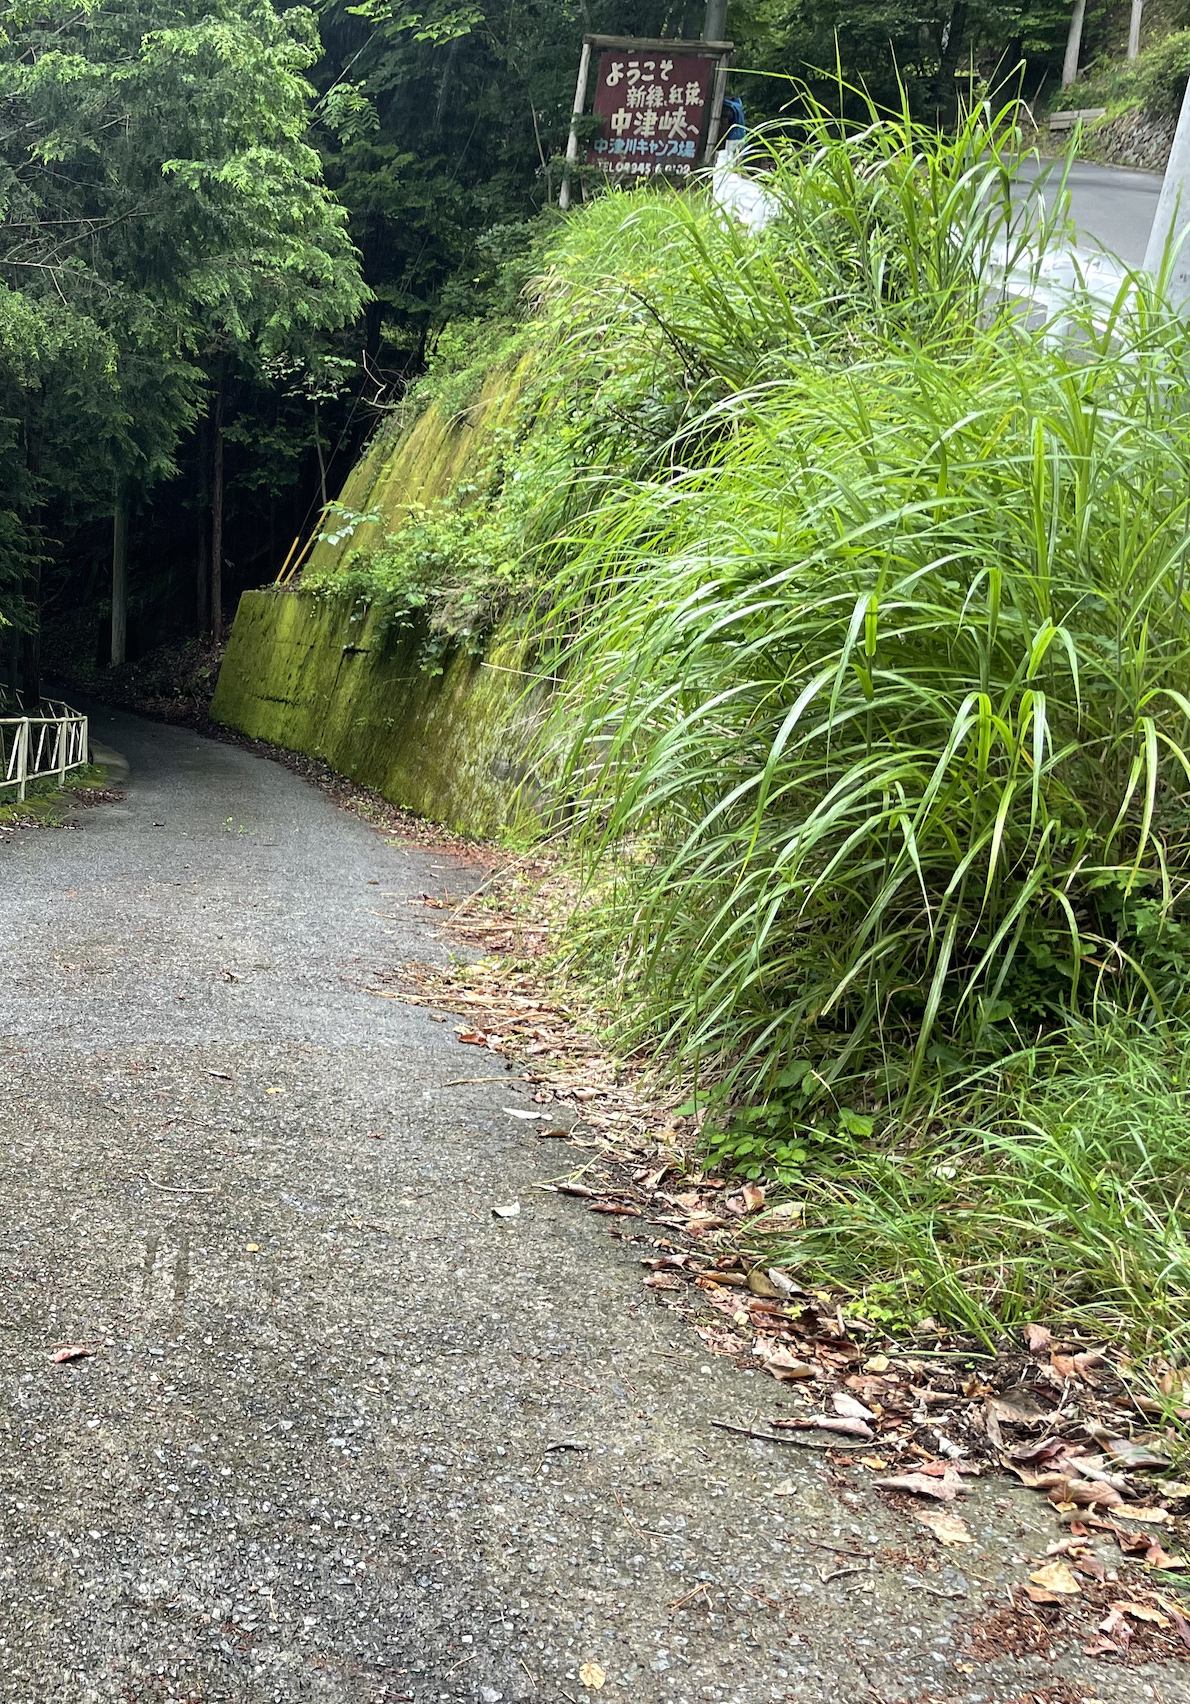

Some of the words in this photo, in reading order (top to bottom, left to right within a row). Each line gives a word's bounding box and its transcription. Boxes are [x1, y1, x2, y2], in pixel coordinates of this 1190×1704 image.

[605, 59, 674, 87] ようこそ
[610, 106, 700, 140] 中津峡へ
[593, 137, 696, 159] 中津川キャンプ場
